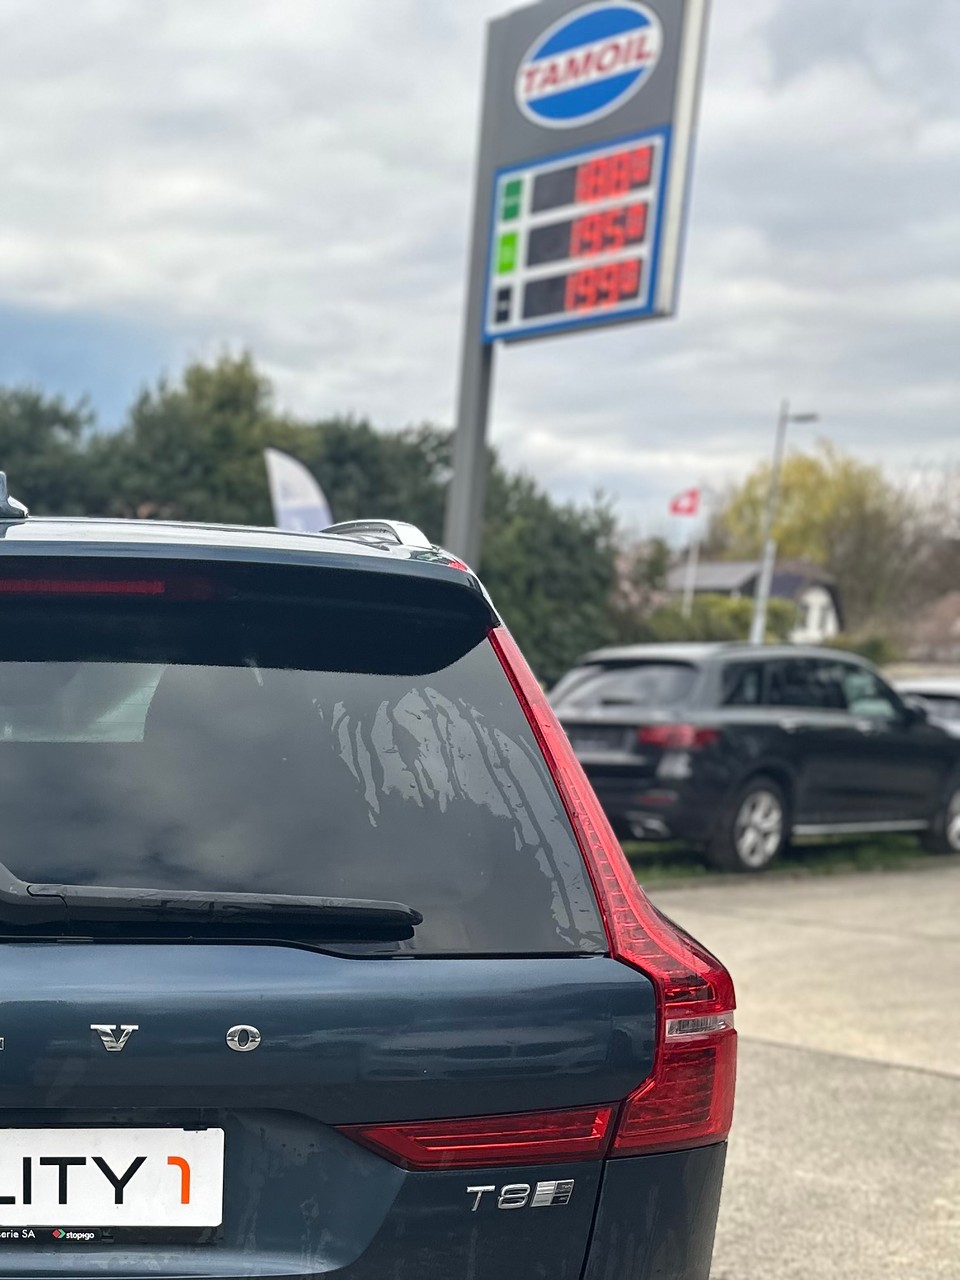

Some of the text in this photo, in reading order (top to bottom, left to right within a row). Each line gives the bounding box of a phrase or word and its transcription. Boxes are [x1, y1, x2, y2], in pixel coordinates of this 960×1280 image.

[522, 34, 653, 95] TAMOIL
[167, 1156, 191, 1204] 1
[466, 1184, 531, 1211] T8
[21, 1229, 36, 1239] SA
